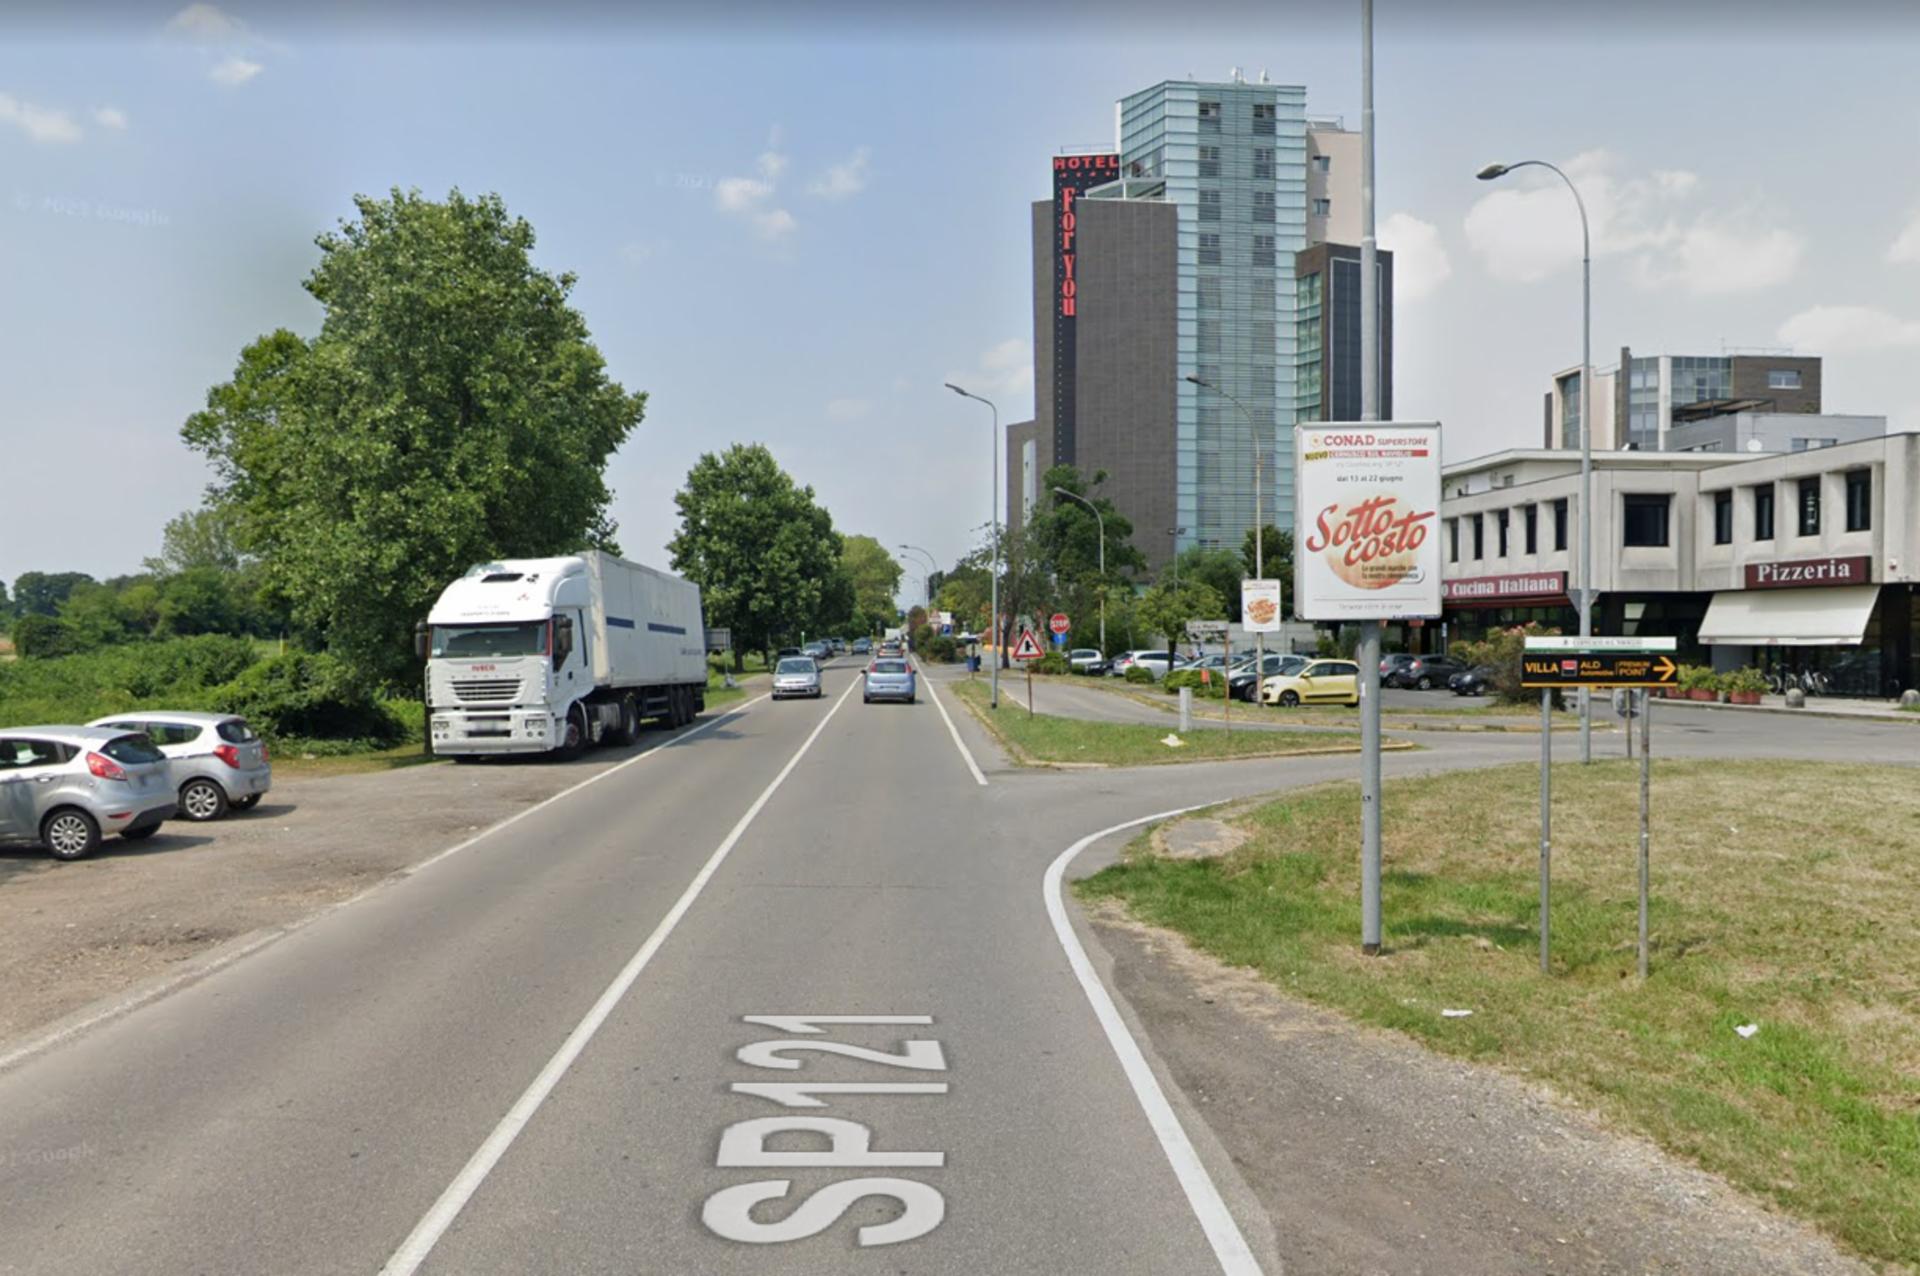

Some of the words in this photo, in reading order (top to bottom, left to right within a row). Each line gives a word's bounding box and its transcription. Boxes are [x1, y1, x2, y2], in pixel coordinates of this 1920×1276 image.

[1054, 156, 1118, 170] HOTEL
[1323, 434, 1375, 446] CONAD
[1378, 438, 1429, 446] SUPERSTORE
[1306, 496, 1397, 553] Sotto
[1344, 511, 1435, 567] costo
[1757, 559, 1850, 583] Pizzeria
[1452, 580, 1494, 596] Cucina
[1499, 577, 1558, 593] Italiana
[1051, 620, 1069, 628] STOP
[1525, 662, 1559, 673] VILLA
[1580, 661, 1600, 669] ALD
[1619, 667, 1647, 676] POINT
[702, 1015, 948, 1246] SP121
